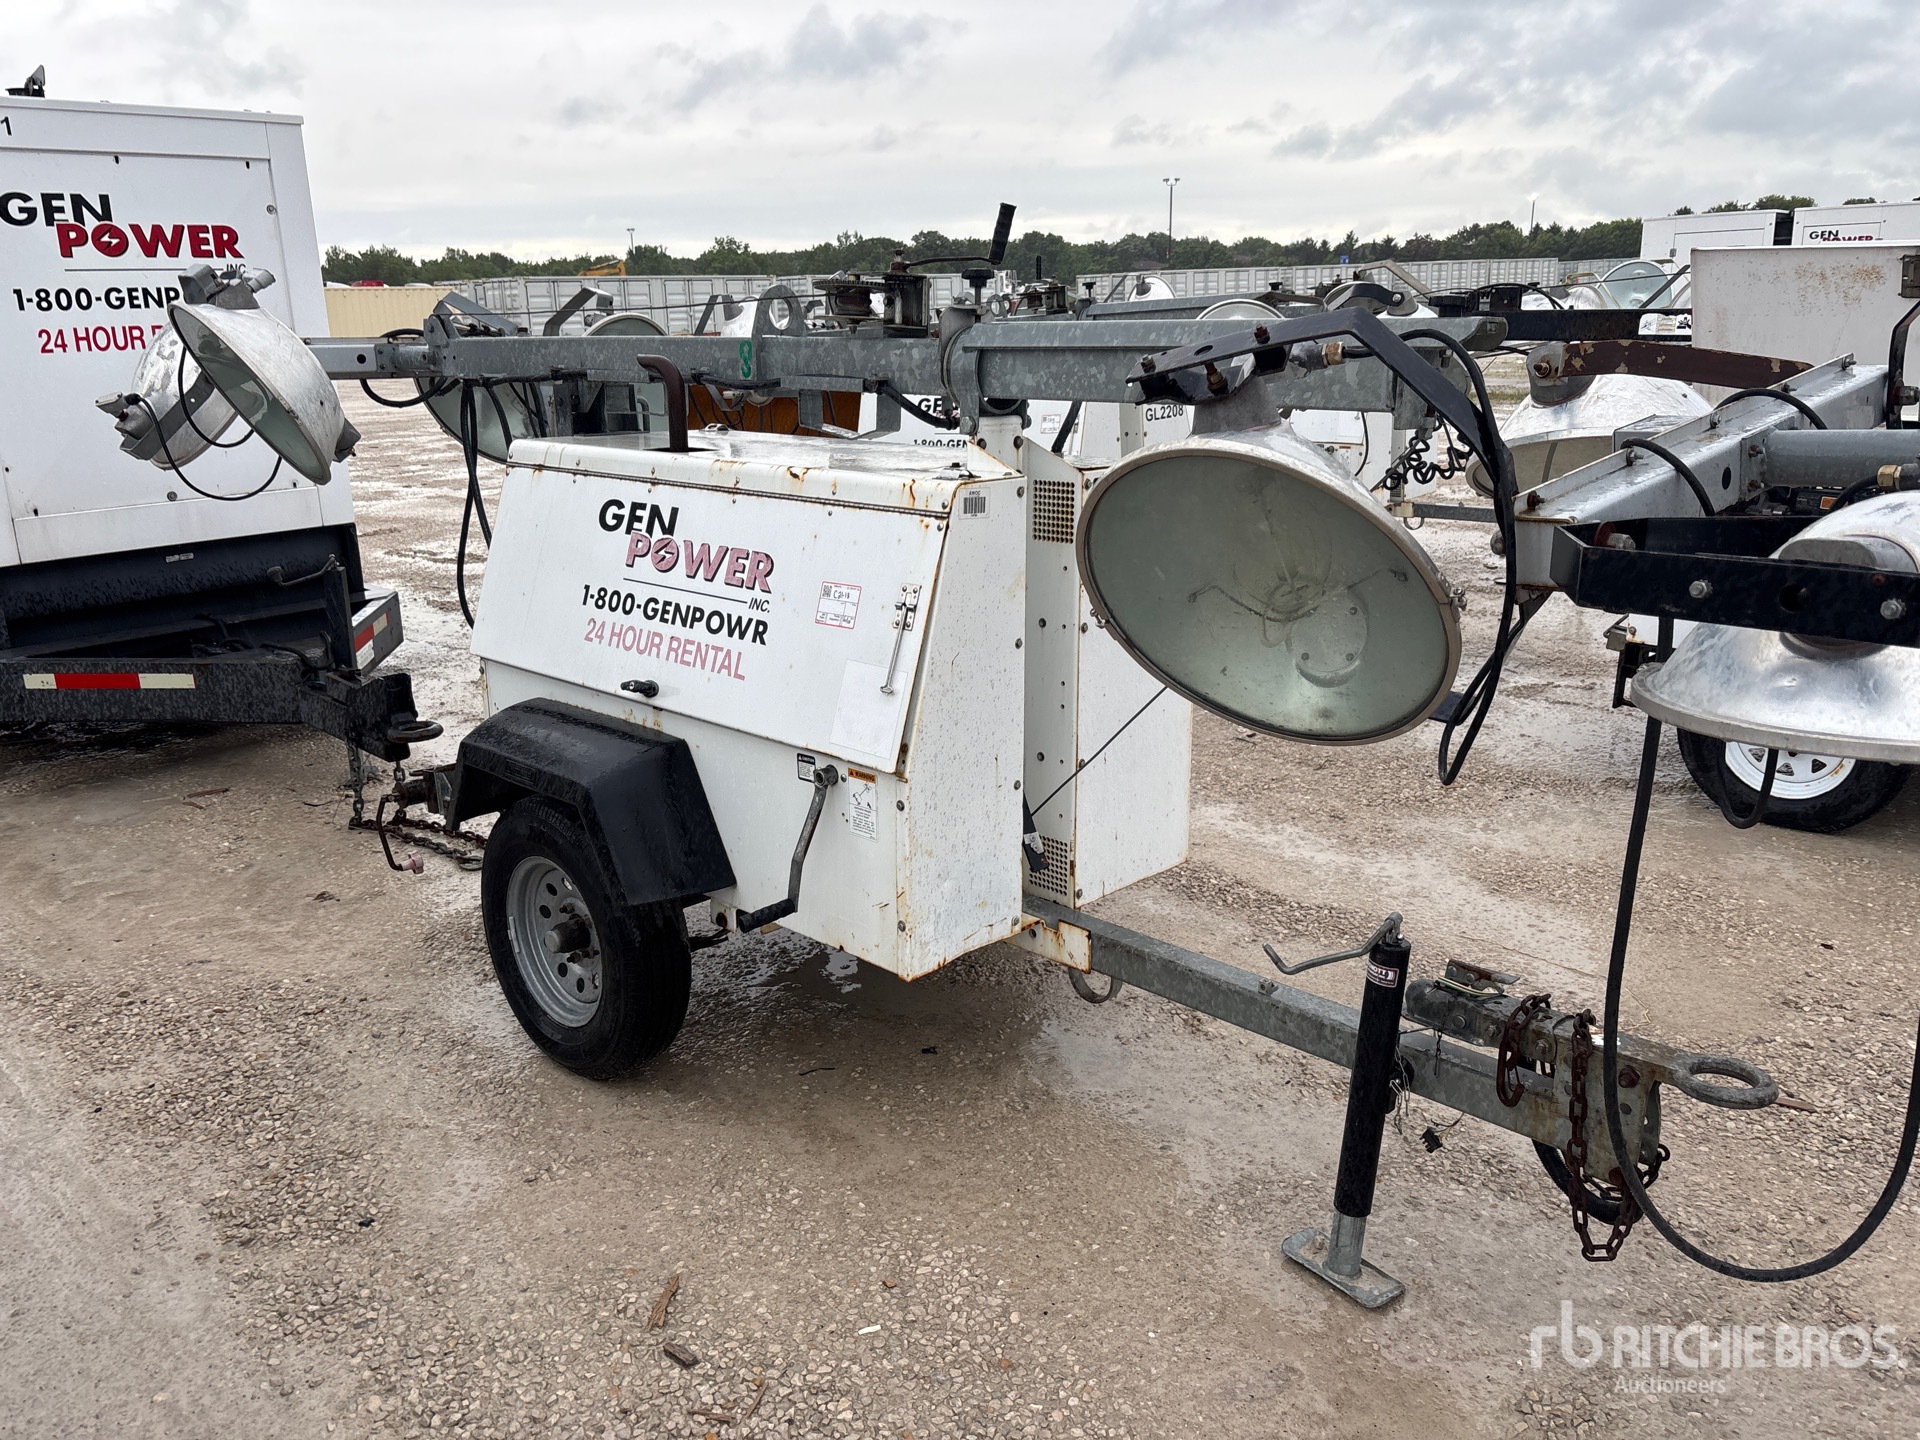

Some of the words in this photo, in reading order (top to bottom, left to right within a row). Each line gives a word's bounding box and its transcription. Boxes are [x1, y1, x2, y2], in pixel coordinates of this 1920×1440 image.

[0, 192, 113, 226] GEN
[55, 223, 245, 259] POWER
[1809, 230, 1839, 240] GEN
[37, 328, 68, 354] 24
[72, 325, 147, 353] HOUR
[918, 398, 958, 414] GE
[1145, 404, 1184, 422] GL2208
[598, 498, 679, 537] GEN
[624, 531, 775, 594] POWER
[582, 583, 770, 646] 1-800-GENPOWR
[748, 597, 770, 613] INC.
[584, 617, 606, 644] 24
[608, 623, 663, 660] HOUR
[665, 634, 746, 681] RENTAL
[855, 771, 875, 782] WARNING
